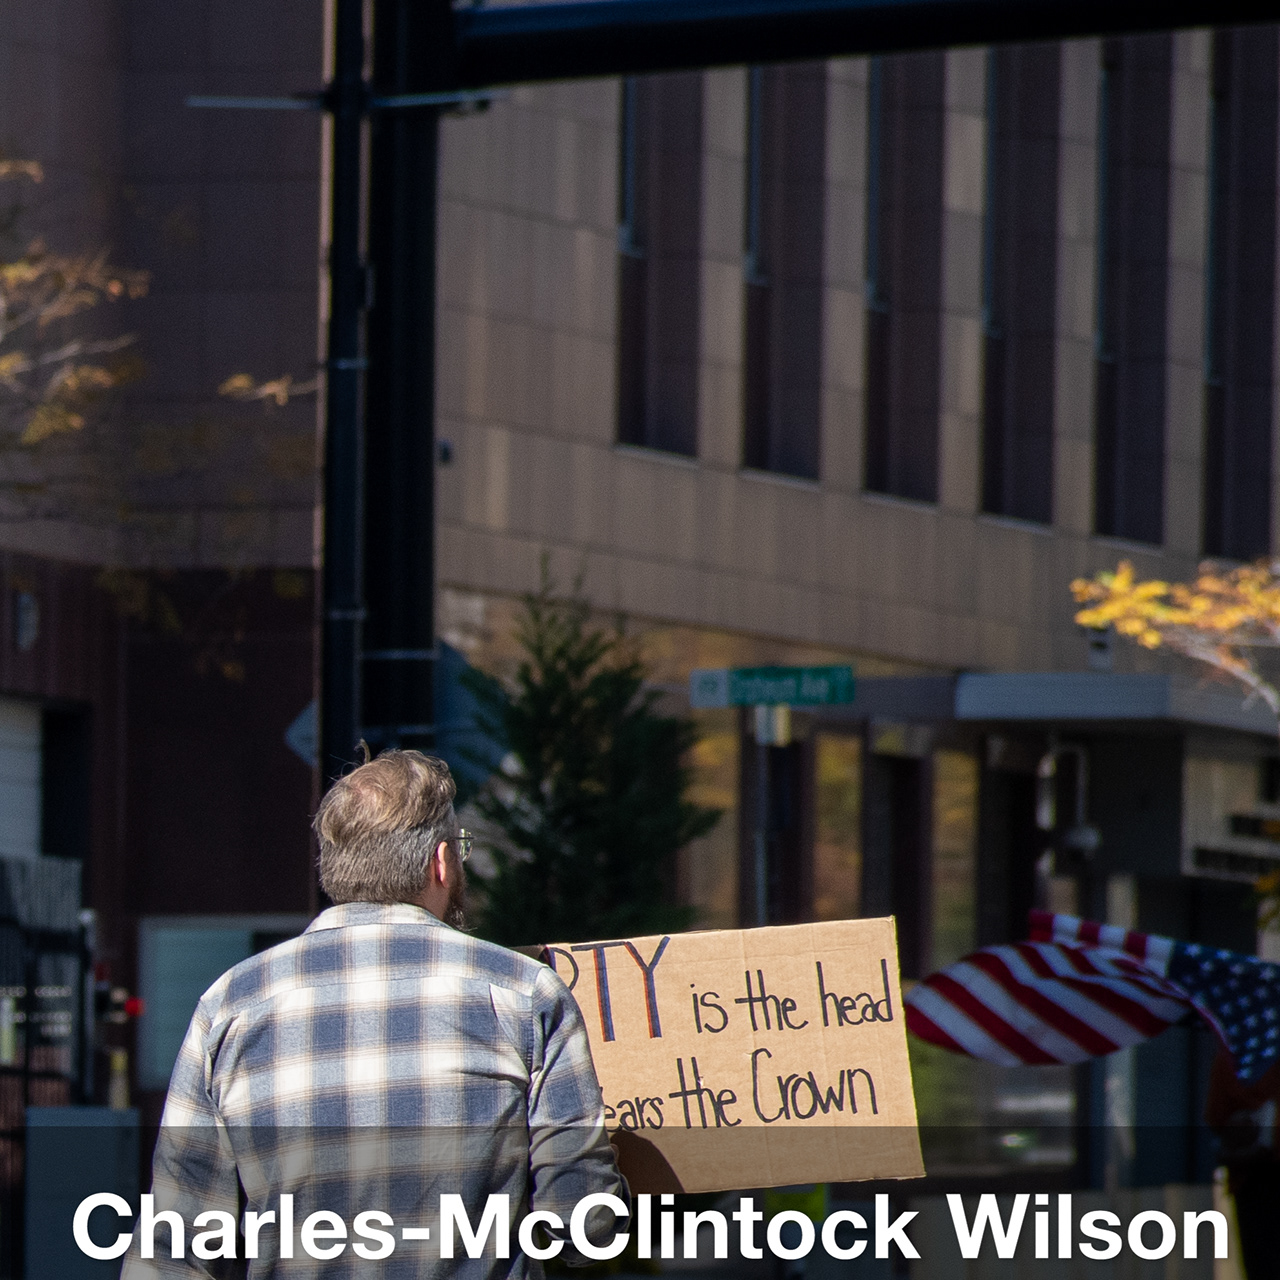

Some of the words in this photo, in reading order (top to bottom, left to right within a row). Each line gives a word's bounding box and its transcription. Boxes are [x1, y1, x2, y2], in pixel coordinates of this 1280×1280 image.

[689, 983, 729, 1034] is
[734, 968, 809, 1032] the
[815, 958, 894, 1028] head
[600, 1085, 665, 1133] ears
[668, 1055, 743, 1130] the
[751, 1047, 879, 1124] Crown
